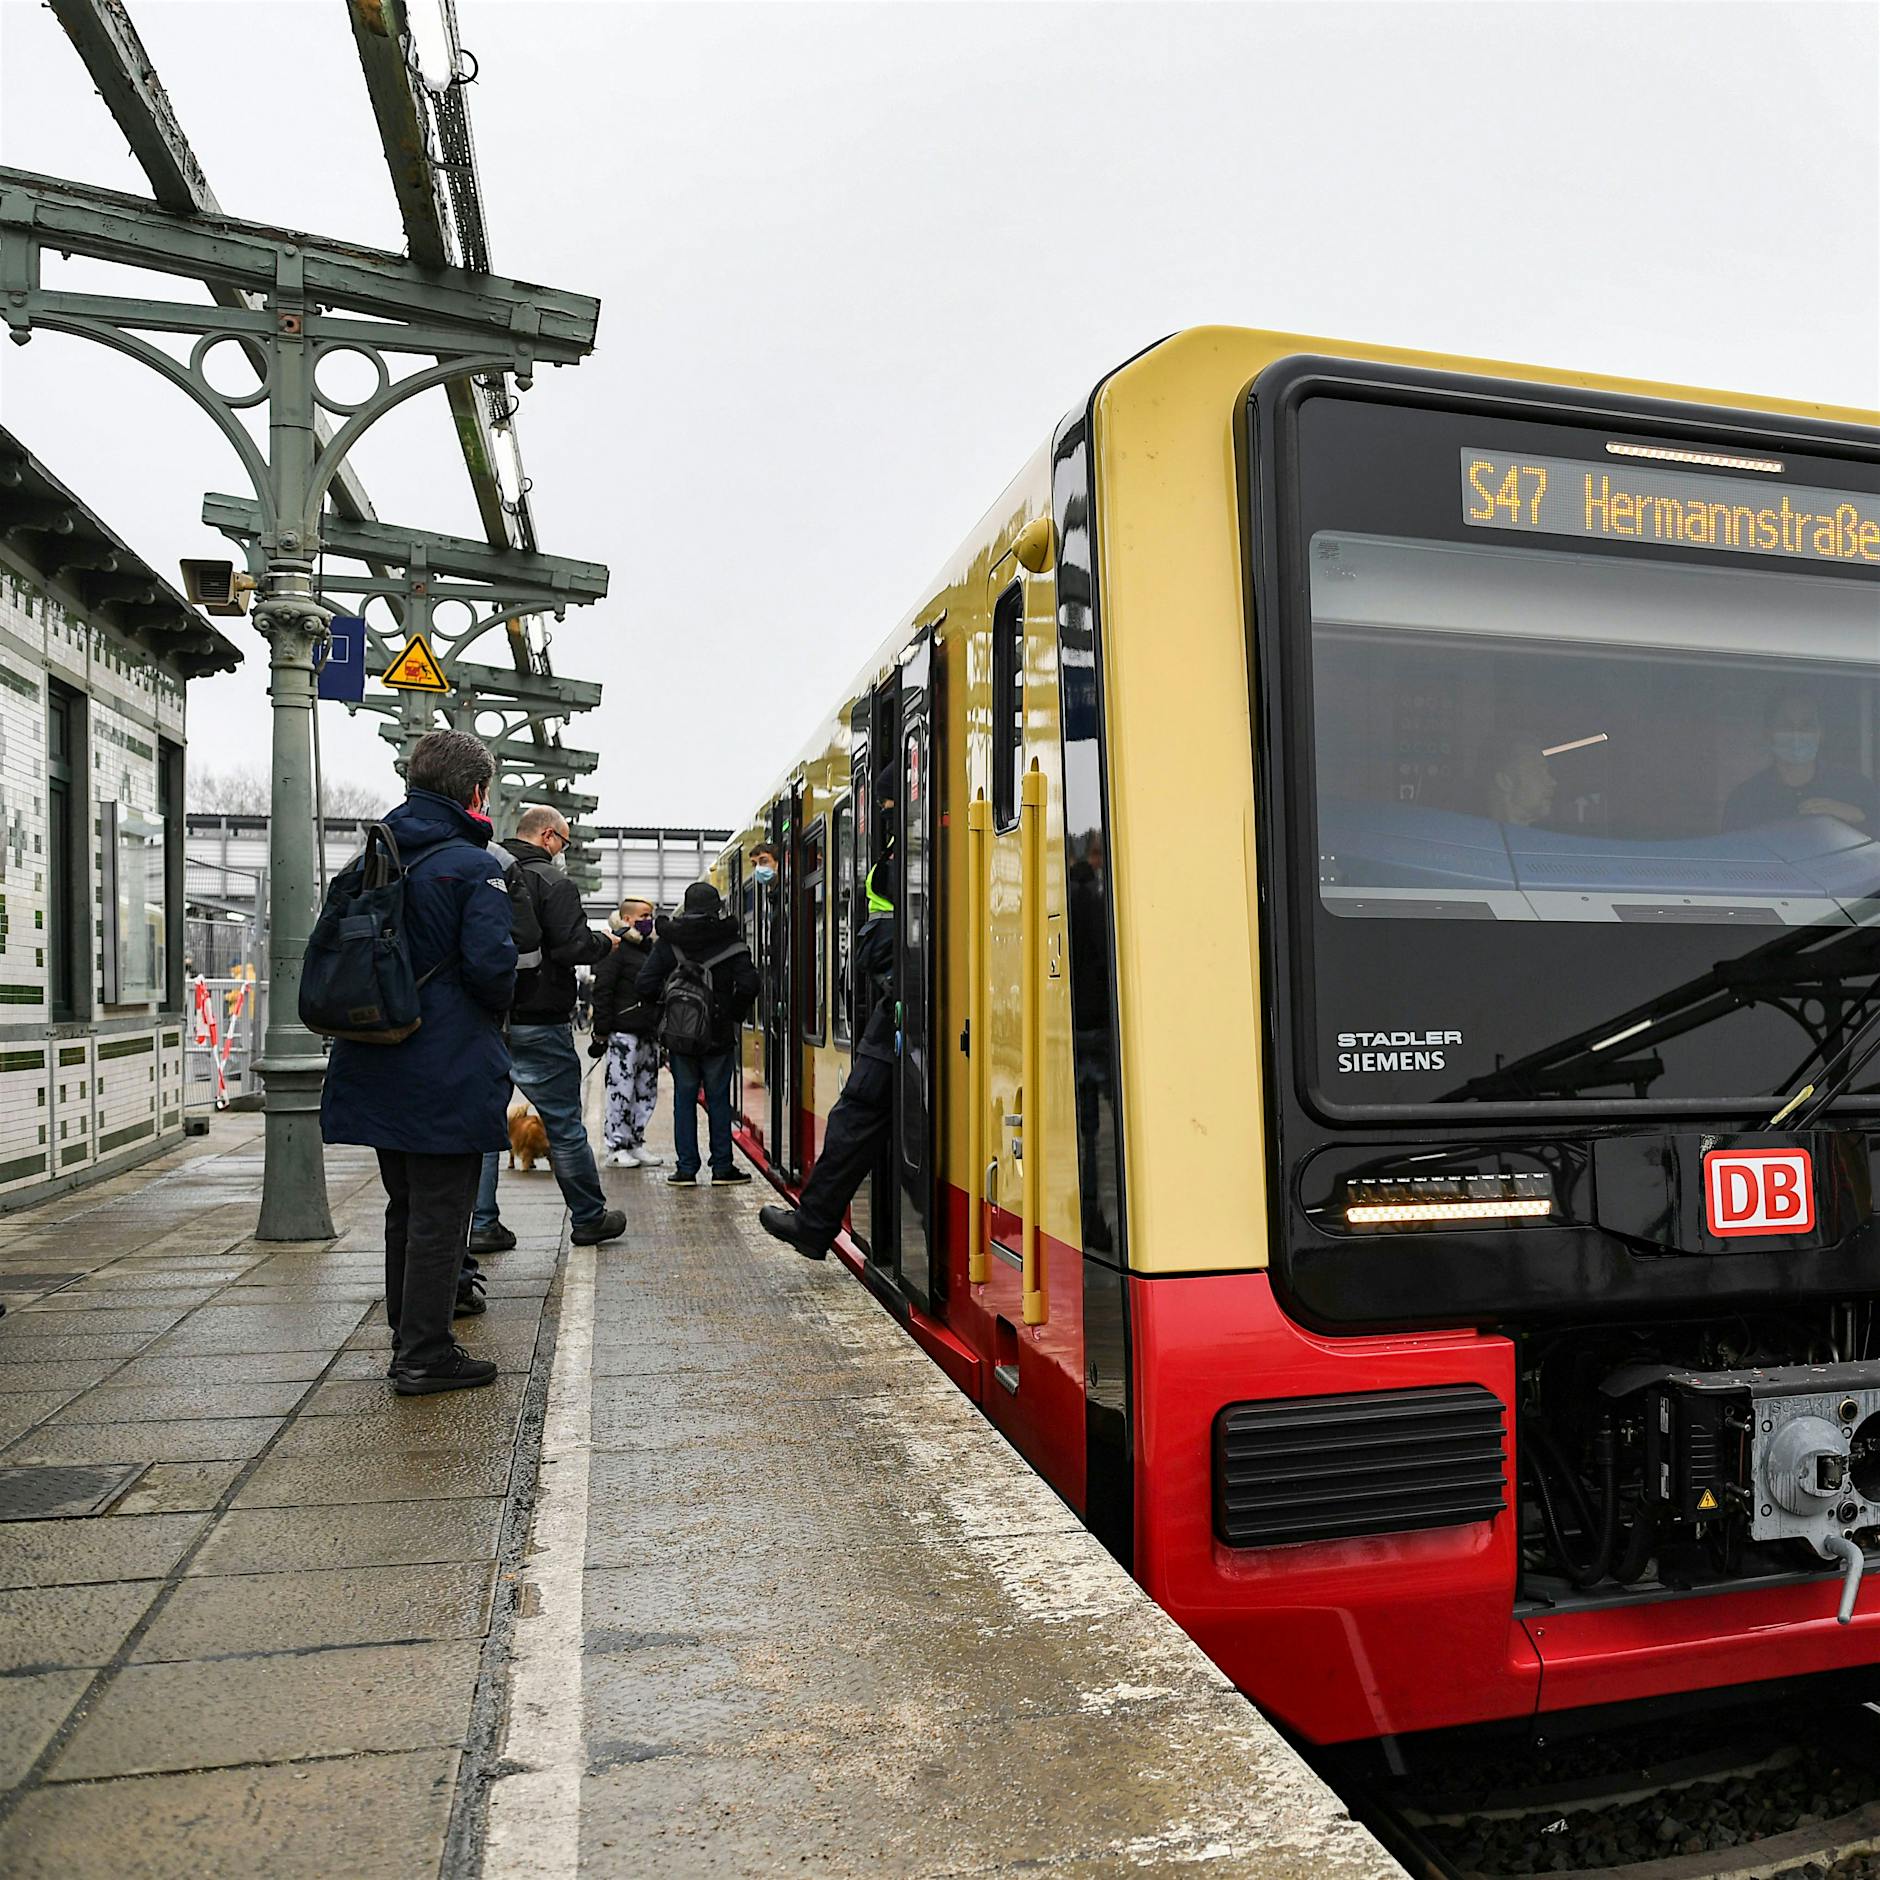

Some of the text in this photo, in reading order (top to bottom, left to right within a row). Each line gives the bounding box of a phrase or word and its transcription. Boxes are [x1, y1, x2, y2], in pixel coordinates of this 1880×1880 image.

[1469, 461, 1880, 561] S47 Hermannstraße
[1337, 1030, 1463, 1047] STADLER
[1338, 1050, 1446, 1073] SIEMENS
[1719, 1163, 1801, 1222] DB
